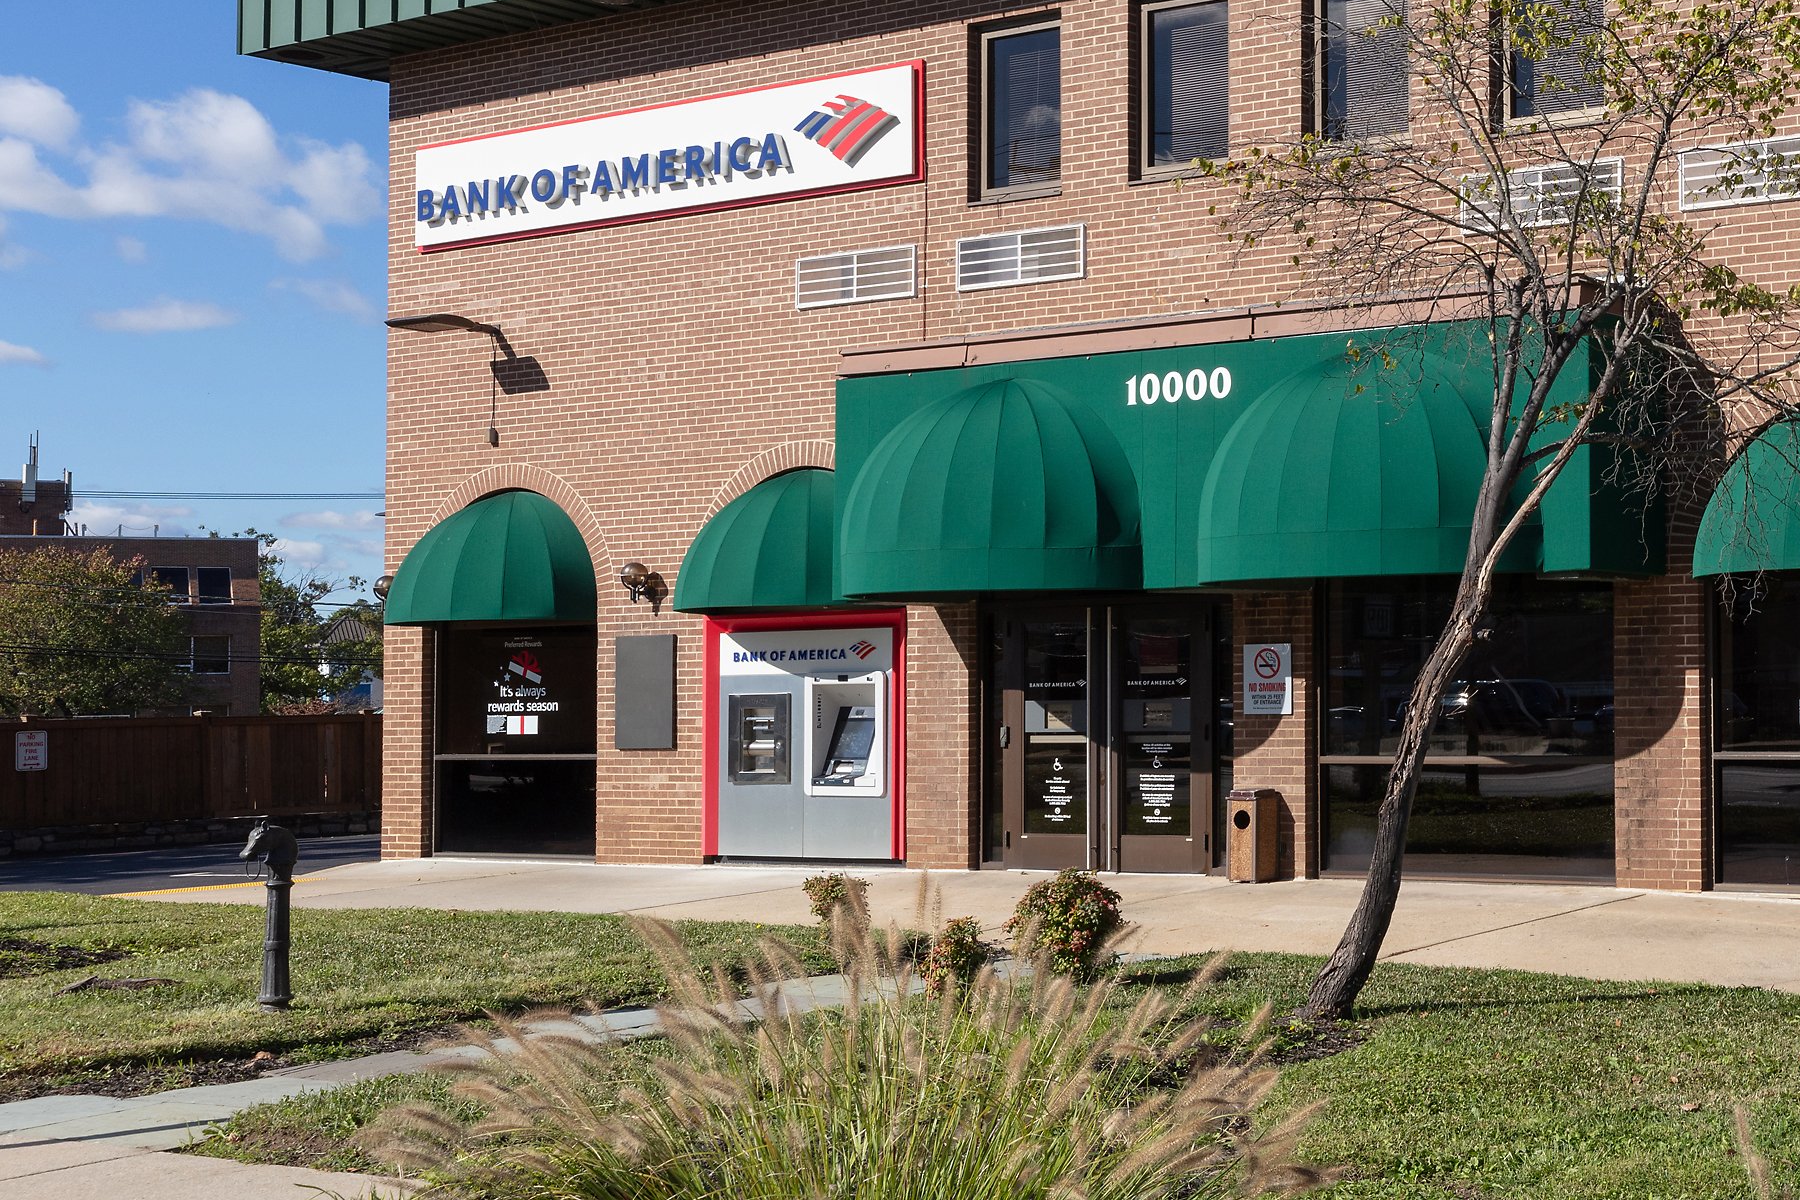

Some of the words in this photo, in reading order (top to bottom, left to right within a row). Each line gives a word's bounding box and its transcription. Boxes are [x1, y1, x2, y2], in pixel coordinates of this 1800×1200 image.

[417, 175, 524, 226] BANK
[531, 164, 586, 203] OF
[591, 132, 790, 198] AMERICA
[1125, 366, 1232, 406] 10000
[733, 652, 767, 663] BANK
[769, 650, 787, 661] OF
[788, 648, 847, 661] AMERICA
[500, 685, 514, 698] It's
[515, 684, 547, 700] always
[1249, 683, 1258, 692] NO
[1258, 683, 1286, 692] SMOKING
[487, 700, 525, 712] rewards
[526, 701, 559, 712] season
